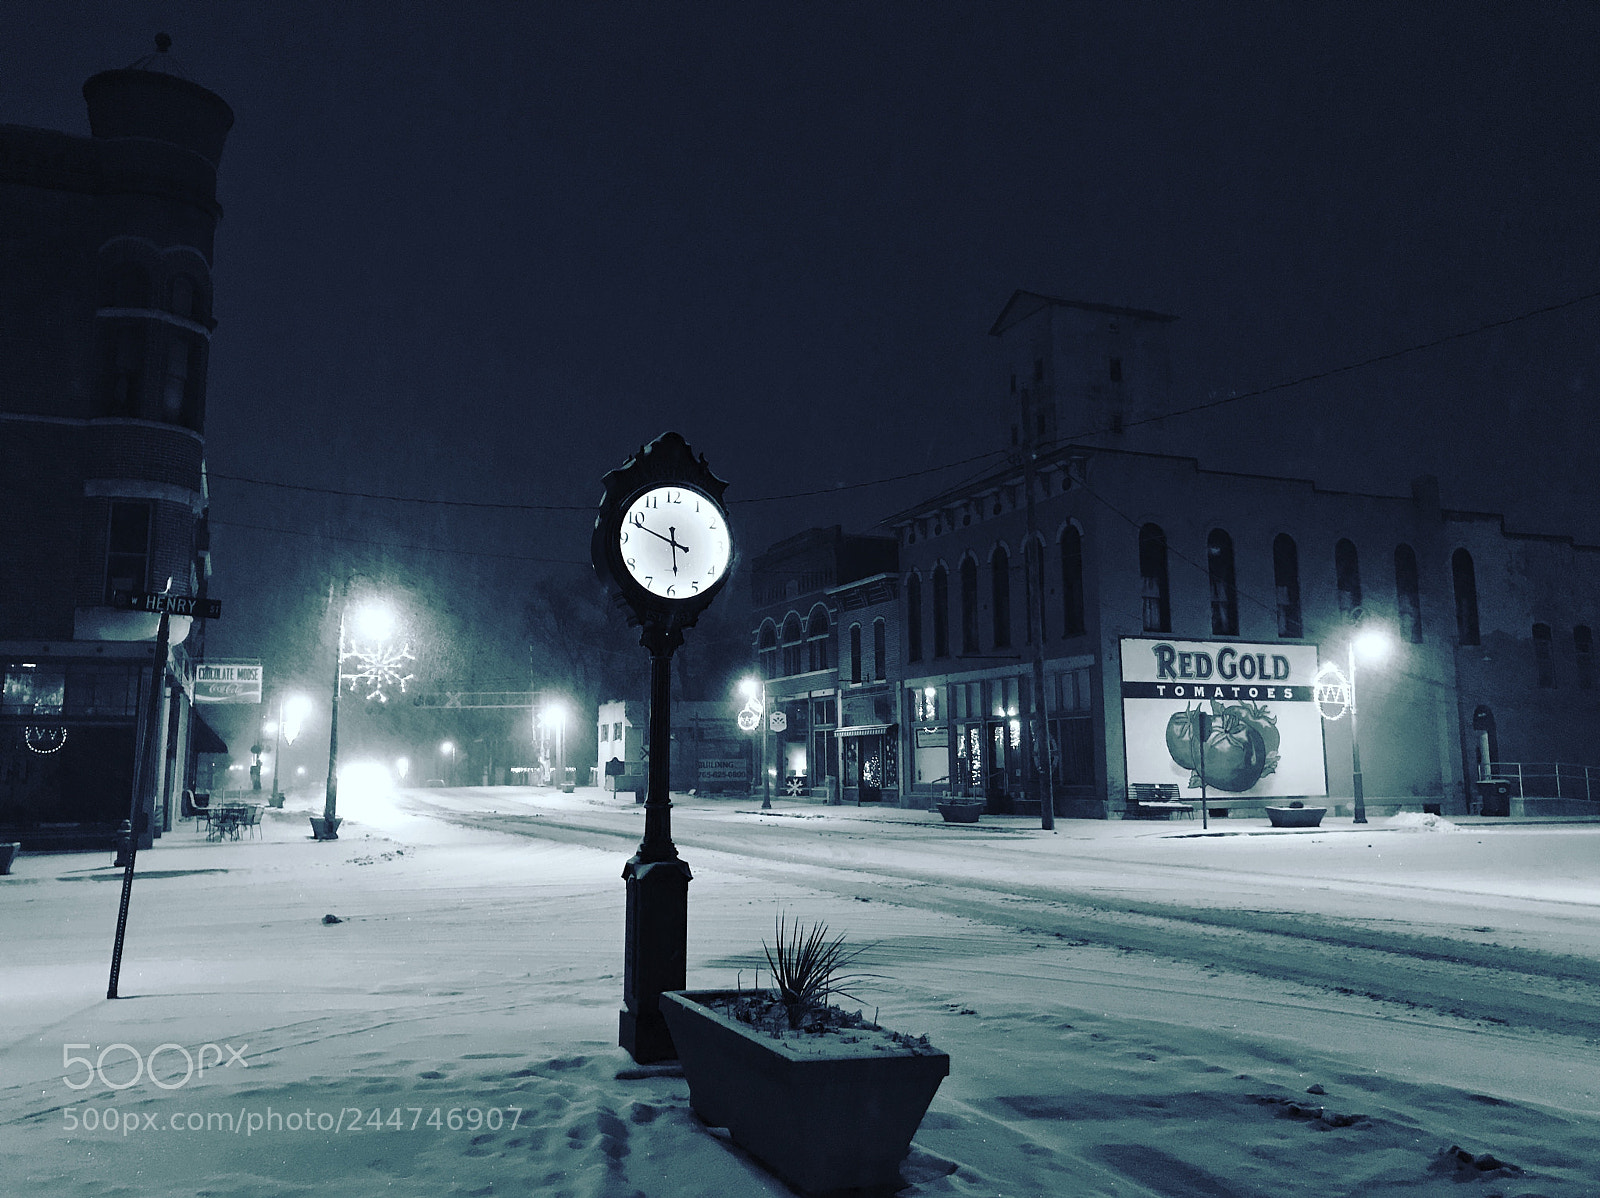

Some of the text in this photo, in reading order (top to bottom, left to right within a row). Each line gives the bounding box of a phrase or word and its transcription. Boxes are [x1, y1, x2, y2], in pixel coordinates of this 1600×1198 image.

[645, 496, 658, 509] 11
[666, 491, 681, 504] 12
[695, 501, 700, 513] 1
[629, 511, 645, 526] 10
[709, 517, 717, 530] 2
[620, 532, 629, 545] 9
[627, 558, 636, 572] 8
[707, 565, 715, 578] 4
[645, 576, 653, 589] 7
[691, 581, 699, 593] 5
[666, 585, 676, 597] 6
[131, 596, 138, 605] W
[146, 594, 197, 614] HENRY
[198, 667, 259, 681] CHOCOLATE MOOSE
[1156, 685, 1293, 699] TOMATOES
